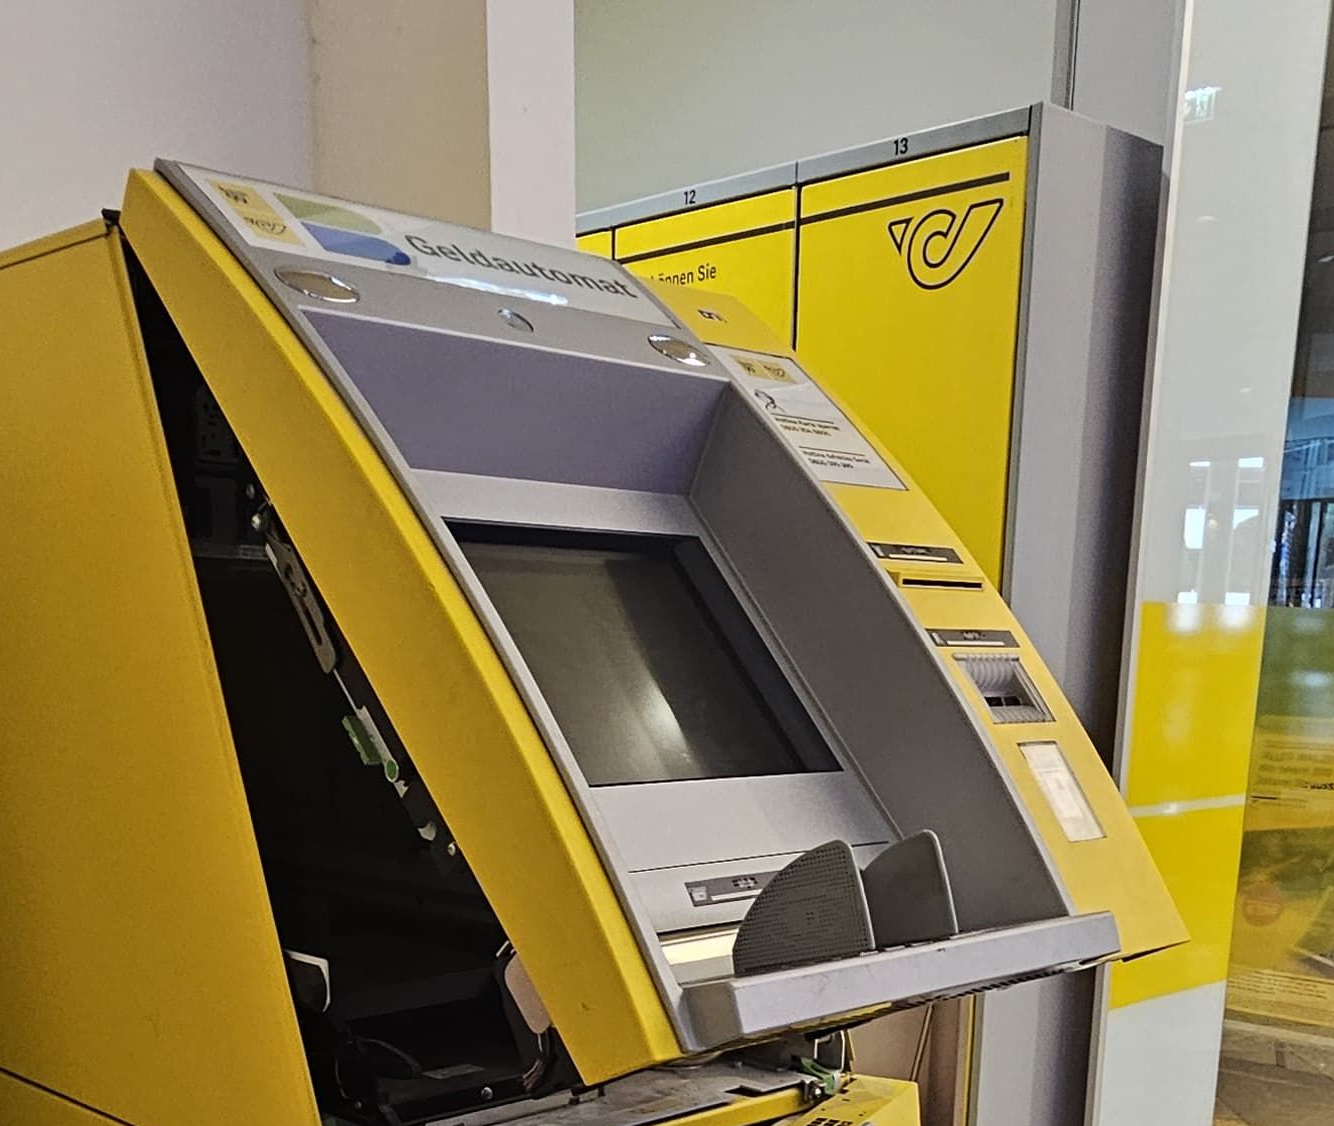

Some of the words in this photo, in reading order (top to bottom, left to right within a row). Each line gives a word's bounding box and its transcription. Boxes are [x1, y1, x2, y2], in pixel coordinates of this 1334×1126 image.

[893, 137, 909, 155] 13
[683, 189, 696, 205] 12
[405, 235, 638, 298] Geldautomat
[697, 262, 717, 282] Sie
